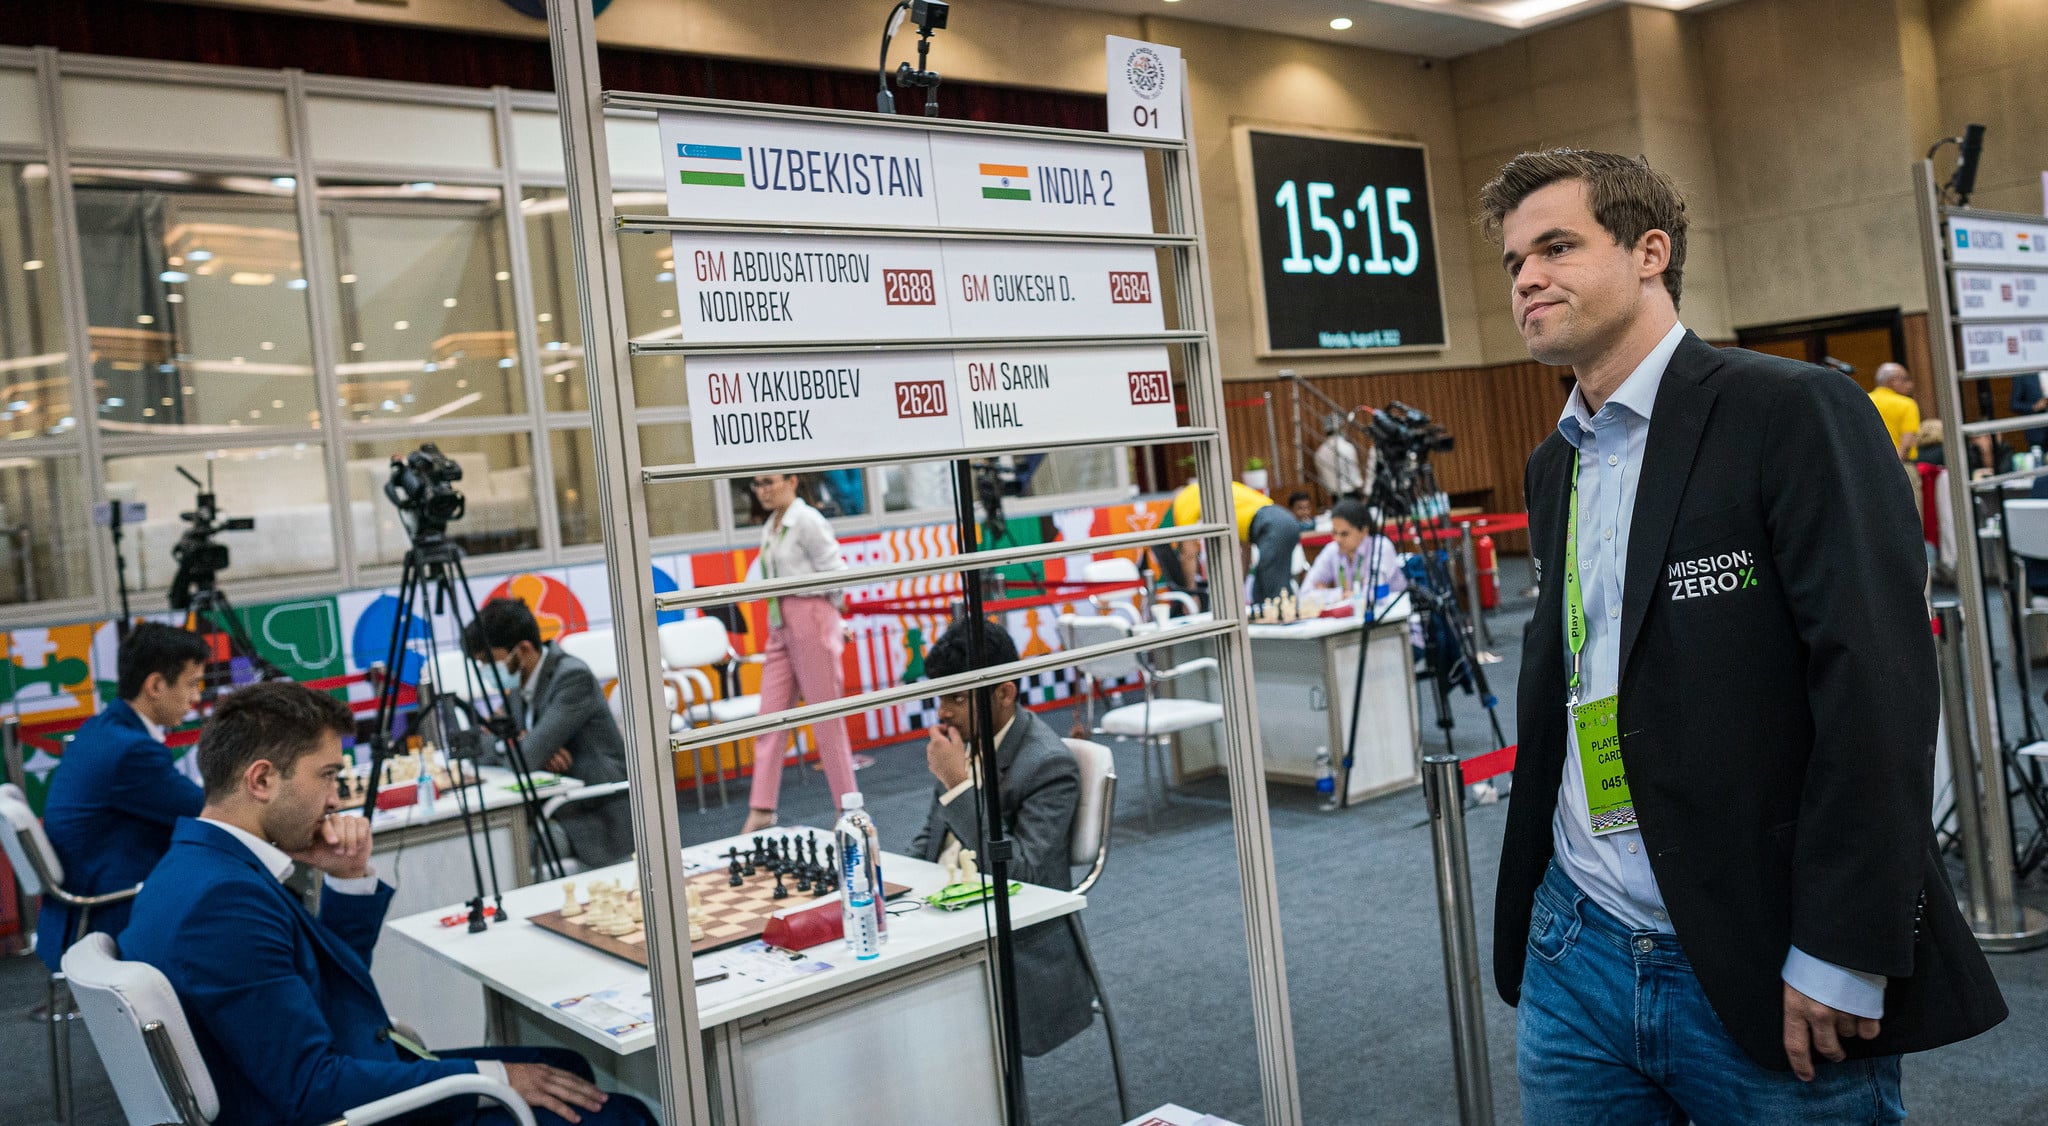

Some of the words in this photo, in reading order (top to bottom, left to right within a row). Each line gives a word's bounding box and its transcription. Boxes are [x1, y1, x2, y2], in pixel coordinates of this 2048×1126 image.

[747, 146, 924, 199] UZBEKISTAN
[1037, 165, 1097, 206] INDIA
[1101, 169, 1116, 207] 2
[1275, 180, 1419, 275] 15:15
[694, 250, 727, 283] GM
[733, 250, 870, 283] ABDUSATTOROV
[886, 272, 933, 303] 2688
[961, 273, 990, 302] GM
[993, 274, 1057, 302] GUKESH
[1059, 275, 1075, 303] D.
[1111, 274, 1150, 301] 2684
[698, 290, 794, 323] NODIRBEK
[707, 372, 743, 406] GM
[746, 368, 860, 403] YAKUBBOEV
[967, 362, 997, 392] GM
[1130, 374, 1169, 403] 2651
[898, 383, 945, 415] 2620
[712, 409, 813, 446] NODIRBEK
[1668, 549, 1754, 580] MISSION:
[1571, 603, 1580, 638] Player
[1592, 735, 1619, 752] PLAYE
[1598, 749, 1622, 765] CARD
